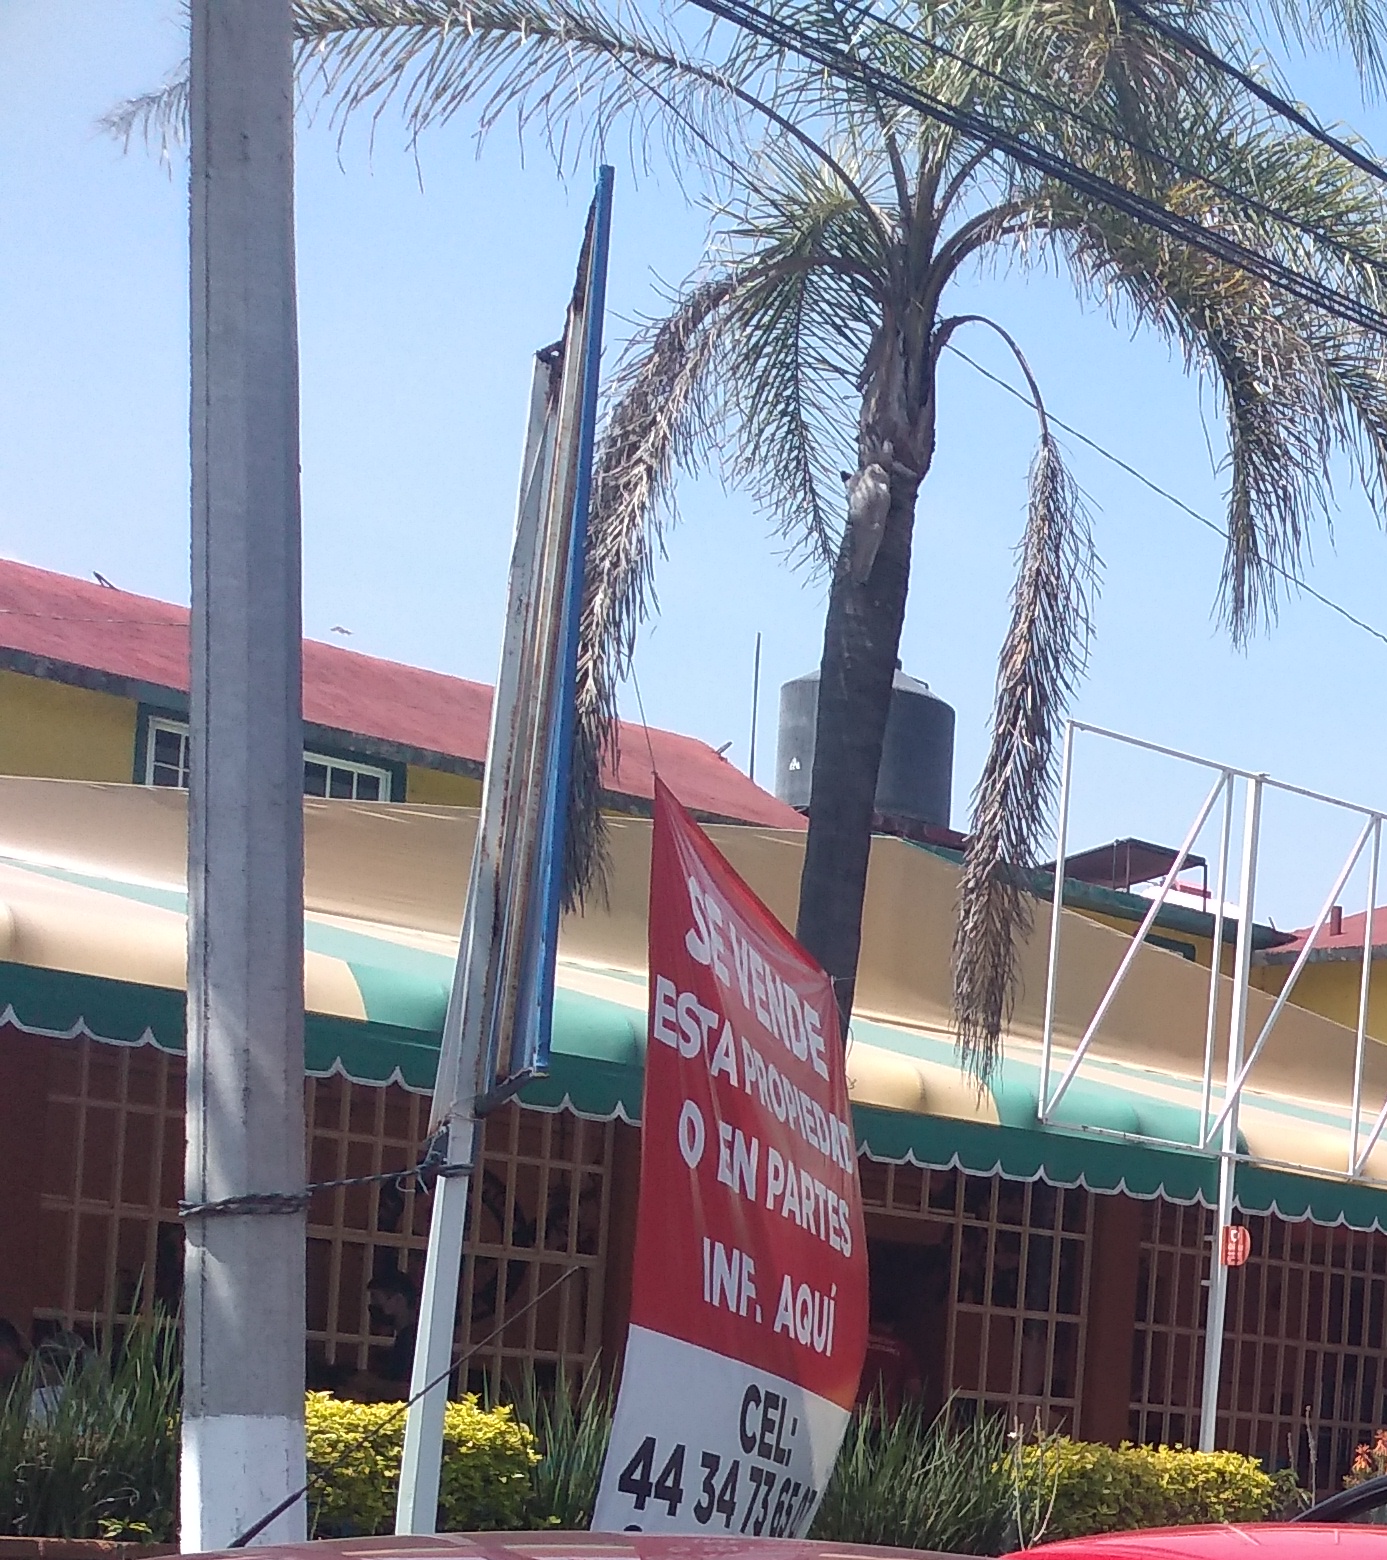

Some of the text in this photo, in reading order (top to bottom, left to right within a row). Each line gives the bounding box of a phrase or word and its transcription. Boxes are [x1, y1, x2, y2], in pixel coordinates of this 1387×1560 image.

[685, 876, 829, 1081] SE VENDE
[654, 974, 853, 1174] ESTA PROPIEDAD
[679, 1100, 852, 1258] O EN PARTES
[703, 1237, 838, 1357] INF. AQUÍ
[618, 1436, 686, 1517] 44
[740, 1383, 798, 1467] CEL:
